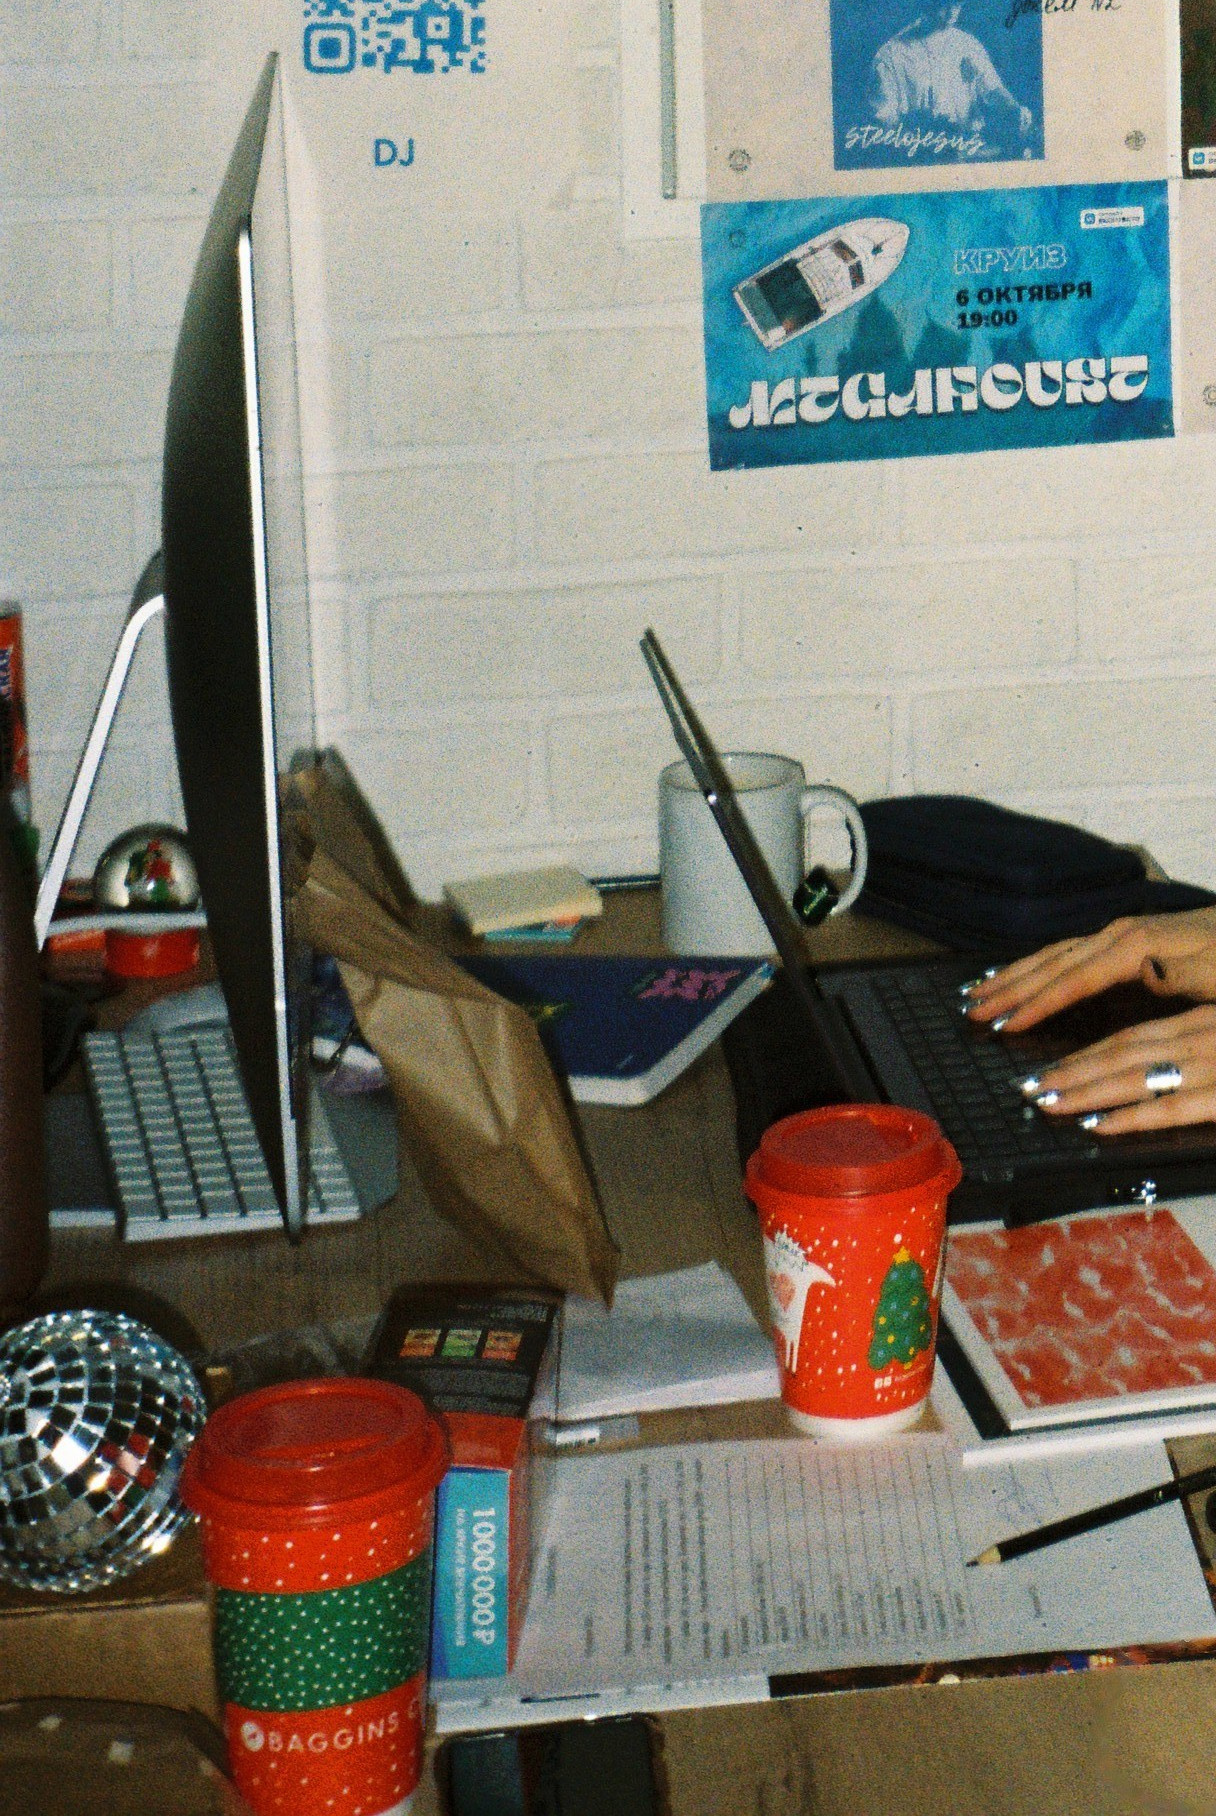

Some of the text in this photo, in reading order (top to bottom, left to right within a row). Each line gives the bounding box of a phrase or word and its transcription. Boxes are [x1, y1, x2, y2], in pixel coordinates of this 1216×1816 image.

[373, 138, 415, 167] DJ
[953, 244, 1068, 274] КРУИЗ
[956, 281, 1092, 307] 6 ОКТЯБРЯ
[957, 309, 1018, 329] 19:00
[268, 1711, 399, 1753] BAGGINS
